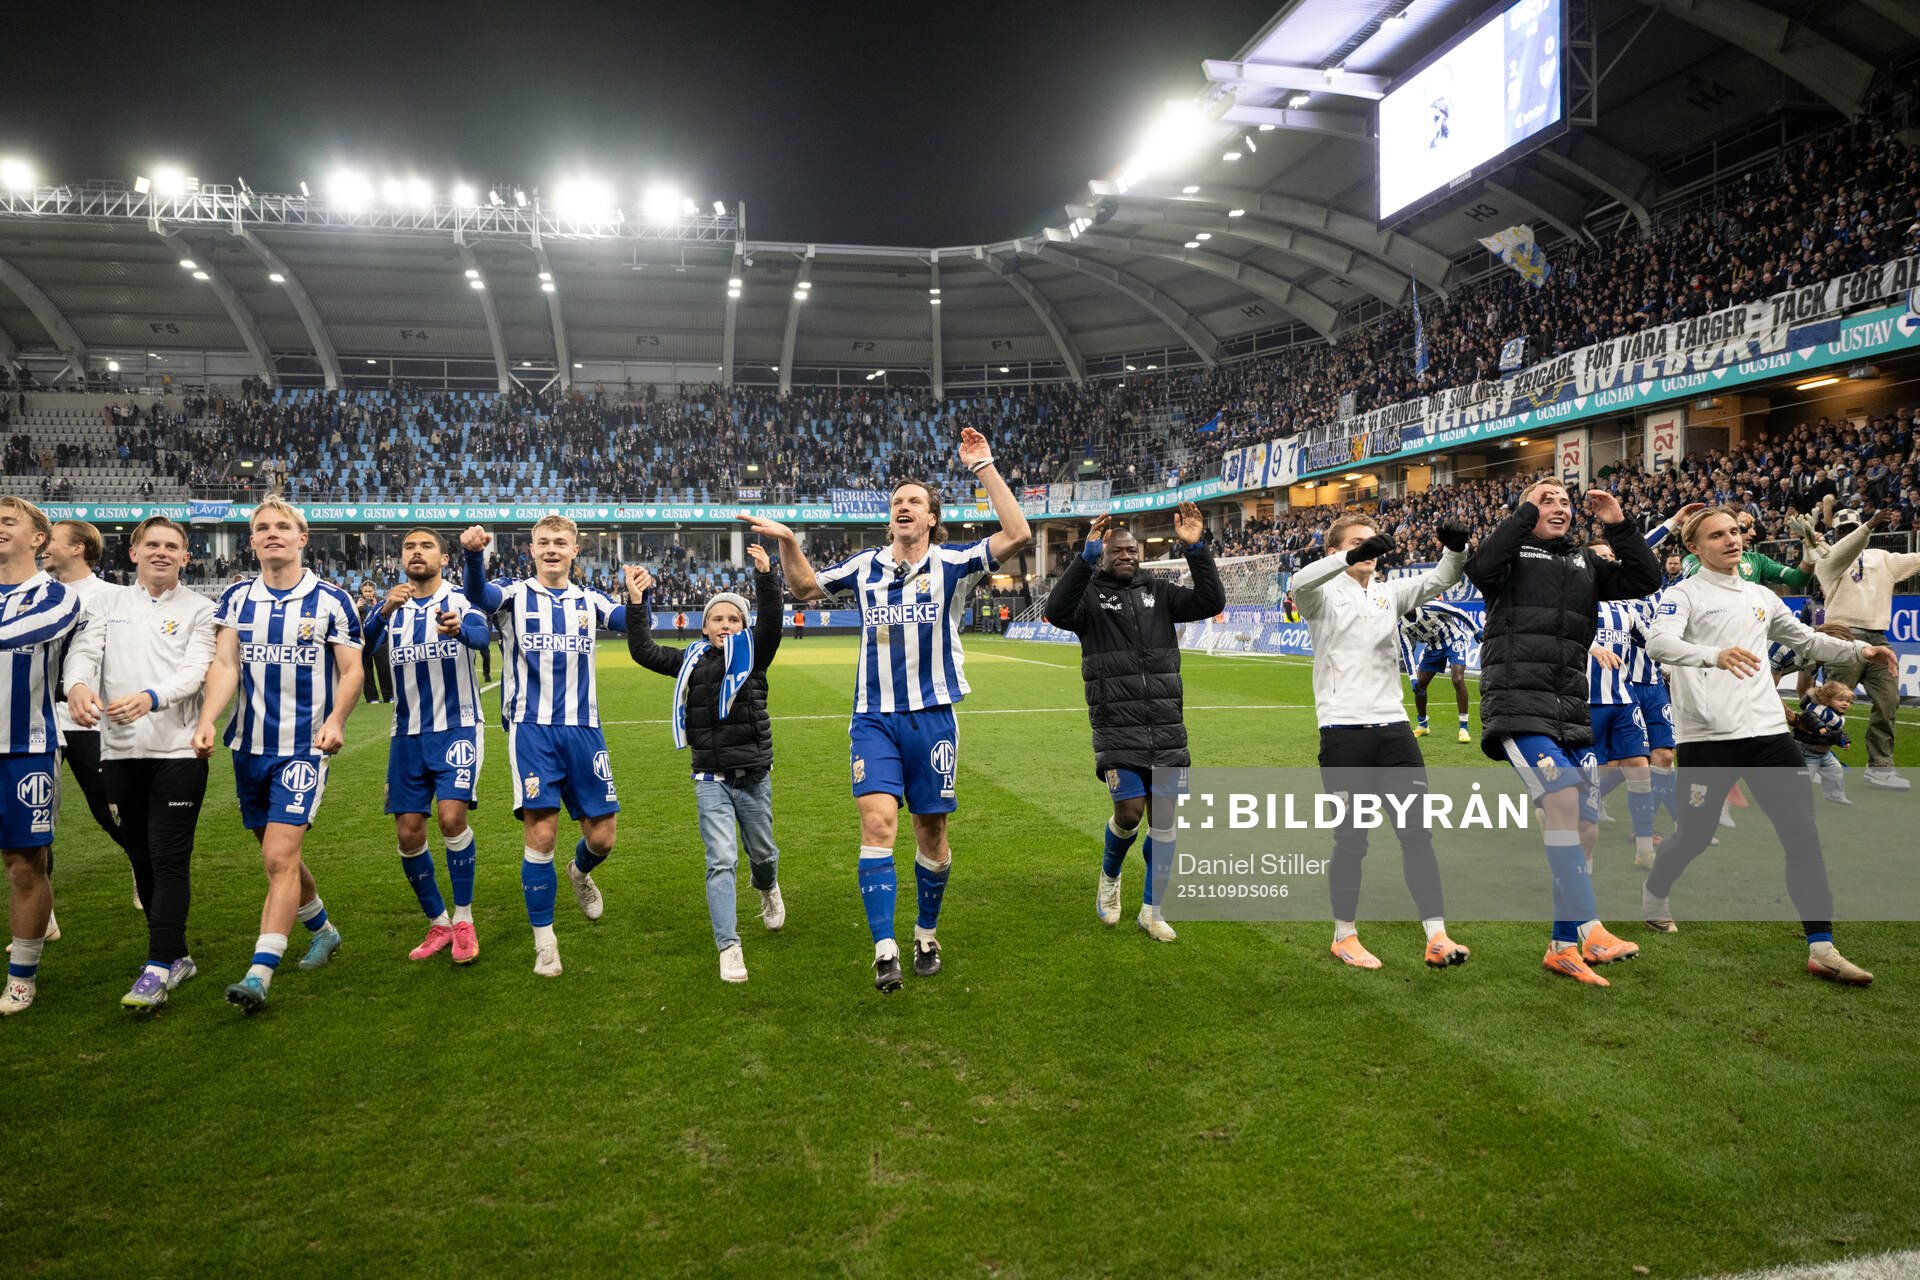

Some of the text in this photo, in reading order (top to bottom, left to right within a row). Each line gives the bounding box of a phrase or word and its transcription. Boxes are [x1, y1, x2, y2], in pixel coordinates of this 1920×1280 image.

[1464, 203, 1498, 222] H3
[150, 322, 180, 335] F5
[400, 329, 430, 341] F4
[636, 335, 660, 346] F3
[1828, 318, 1895, 355] GUSTAV
[852, 341, 876, 352] F2
[992, 340, 1012, 351] F1
[1427, 391, 1446, 415] DIG
[1449, 384, 1473, 409] SOM
[1512, 352, 1577, 397] KRIGADE
[1584, 338, 1615, 375] FÖR
[1771, 280, 1831, 327] TACK
[1595, 384, 1636, 408] GUSTAV
[1536, 400, 1573, 421] GUSTAV
[739, 489, 762, 499] HSK
[94, 508, 130, 518] GUSTAV
[151, 508, 185, 518] GUSTAV
[311, 508, 344, 518] GUSTAV
[363, 508, 396, 518] GUSTAV
[415, 508, 448, 518] GUSTAV
[466, 508, 498, 518] GUSTAV
[516, 508, 549, 518] GUSTAV
[565, 508, 597, 518] GUSTAV
[614, 508, 646, 518] GUSTAV
[662, 508, 693, 518] GUSTAV
[756, 508, 785, 518] GUSTAV
[802, 508, 832, 518] GUSTAV
[963, 508, 992, 519] GUSTAV
[863, 602, 939, 628] SERNEKE
[521, 632, 593, 655] SERNEKE
[391, 639, 458, 666] SERNEKE
[448, 742, 474, 765] MG
[933, 743, 953, 771] MG
[285, 763, 314, 789] MG
[455, 768, 471, 782] 29
[943, 774, 953, 789] 13
[20, 775, 52, 805] MG
[294, 793, 304, 806] 9
[32, 809, 50, 824] 22
